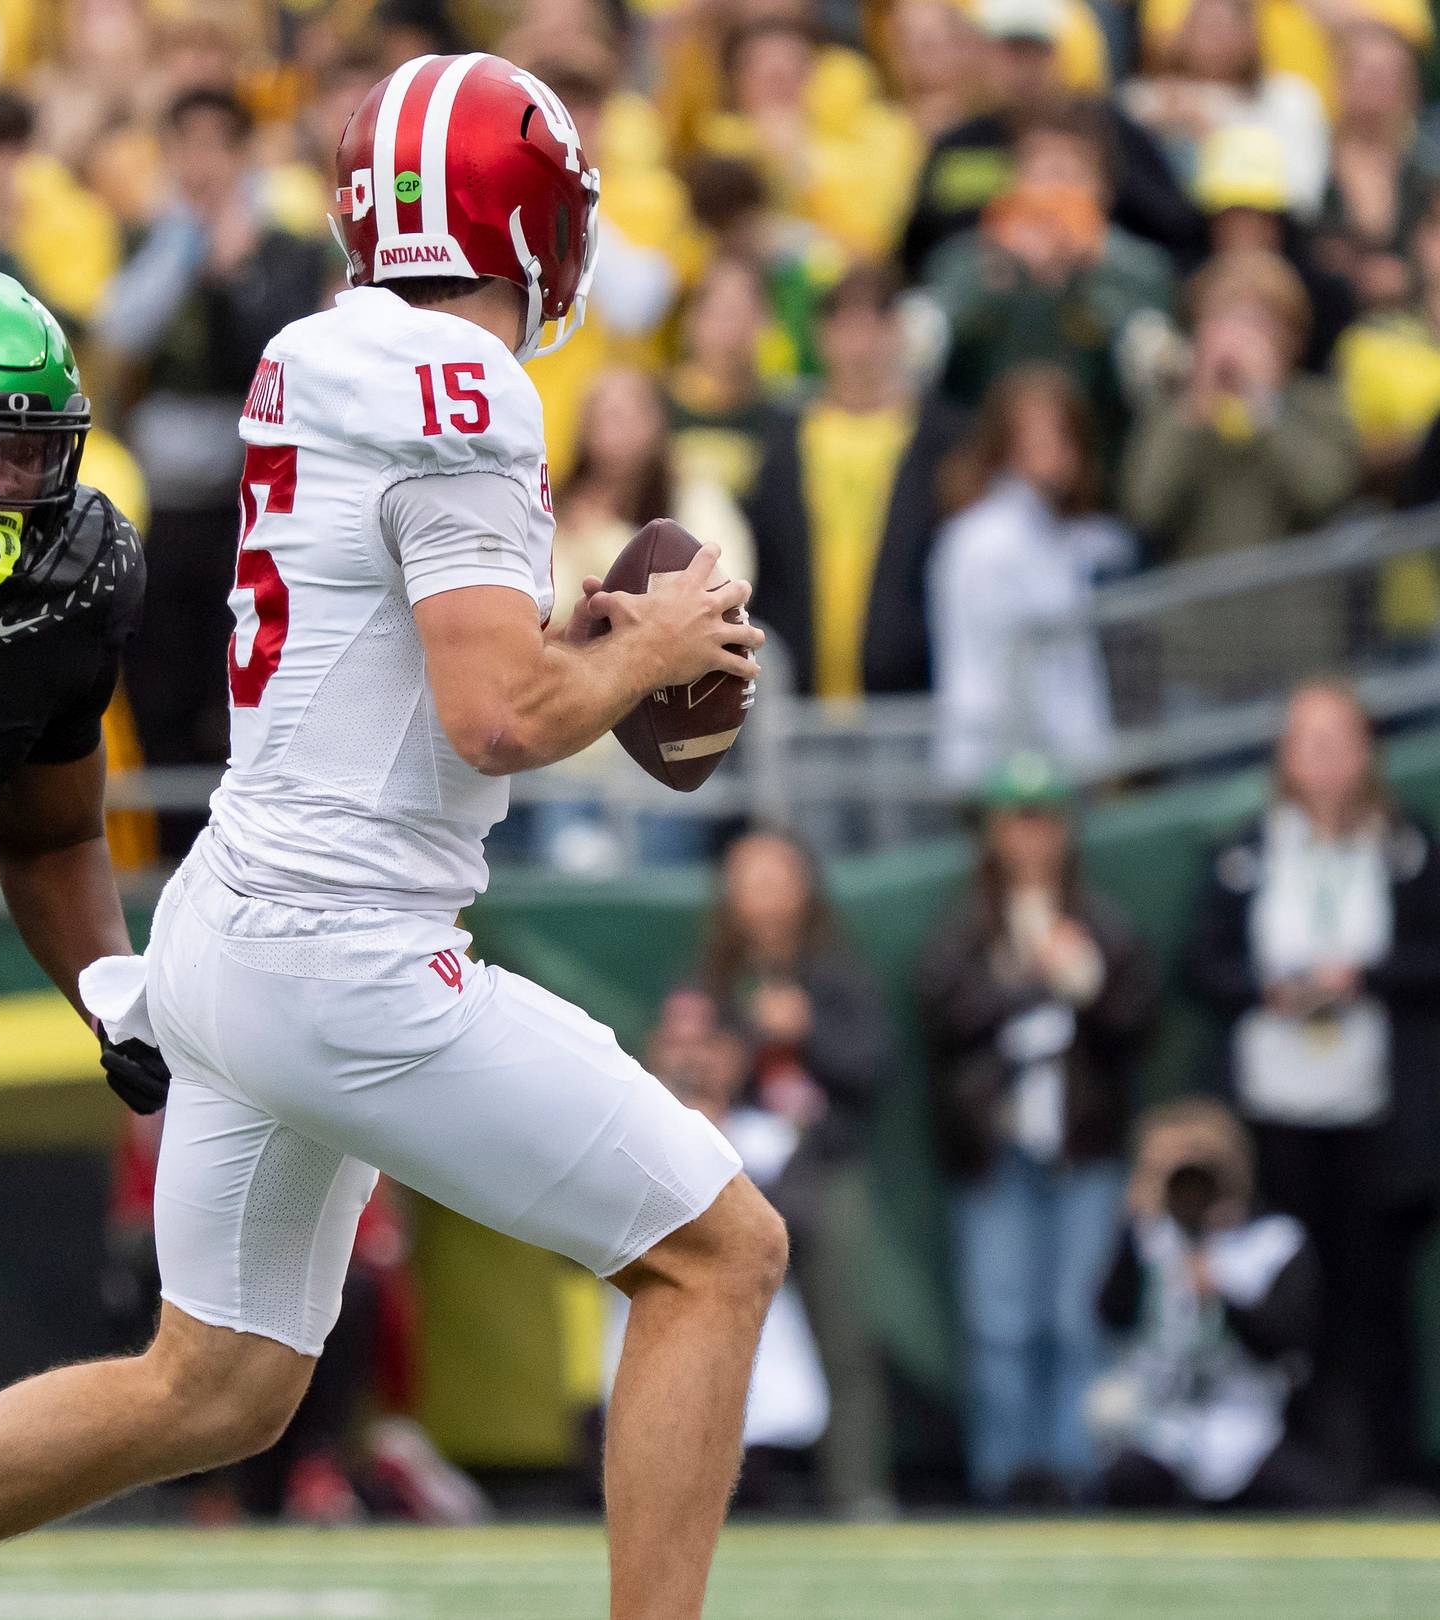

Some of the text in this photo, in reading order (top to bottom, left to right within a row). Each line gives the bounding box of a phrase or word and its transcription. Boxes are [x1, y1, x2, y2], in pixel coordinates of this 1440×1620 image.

[396, 179, 420, 193] C2P
[379, 246, 451, 266] INDIANA
[8, 393, 30, 412] O
[415, 362, 492, 436] 15
